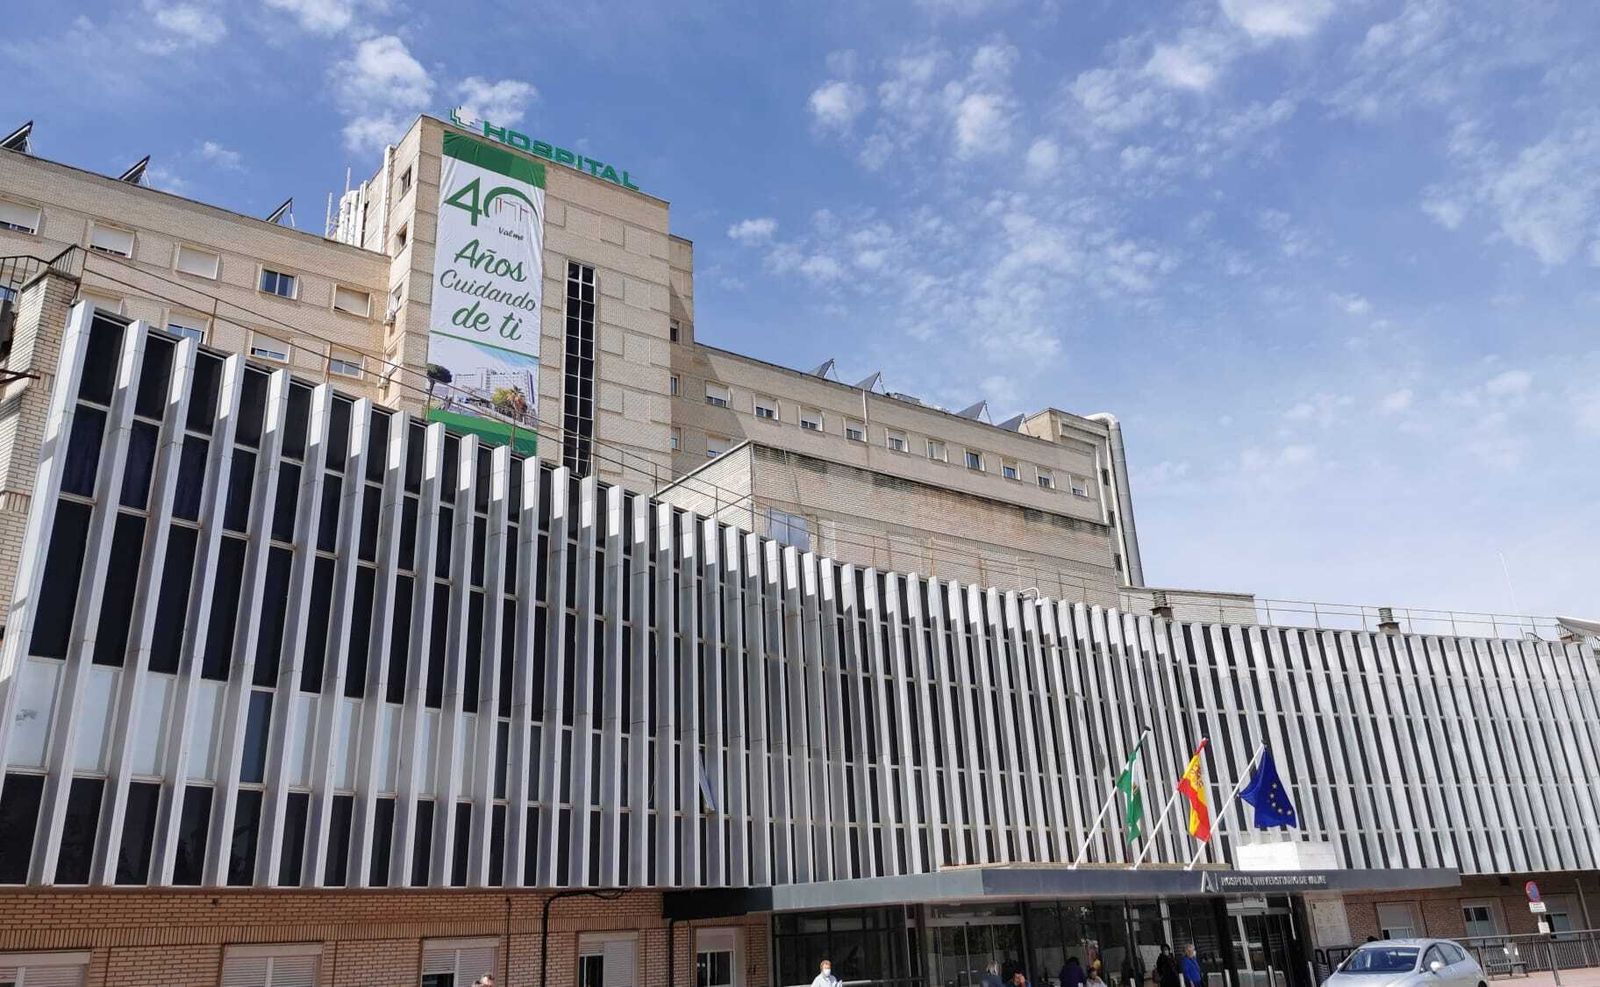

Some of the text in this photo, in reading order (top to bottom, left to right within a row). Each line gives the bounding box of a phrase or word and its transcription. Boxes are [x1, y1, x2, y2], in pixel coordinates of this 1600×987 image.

[483, 120, 640, 191] HOSPITAL
[498, 226, 524, 241] Valme
[454, 238, 527, 283] Años
[440, 269, 536, 312] Cuidando
[451, 300, 523, 341] de ti
[1220, 876, 1253, 886] HOSPITAL
[1299, 876, 1308, 885] DE
